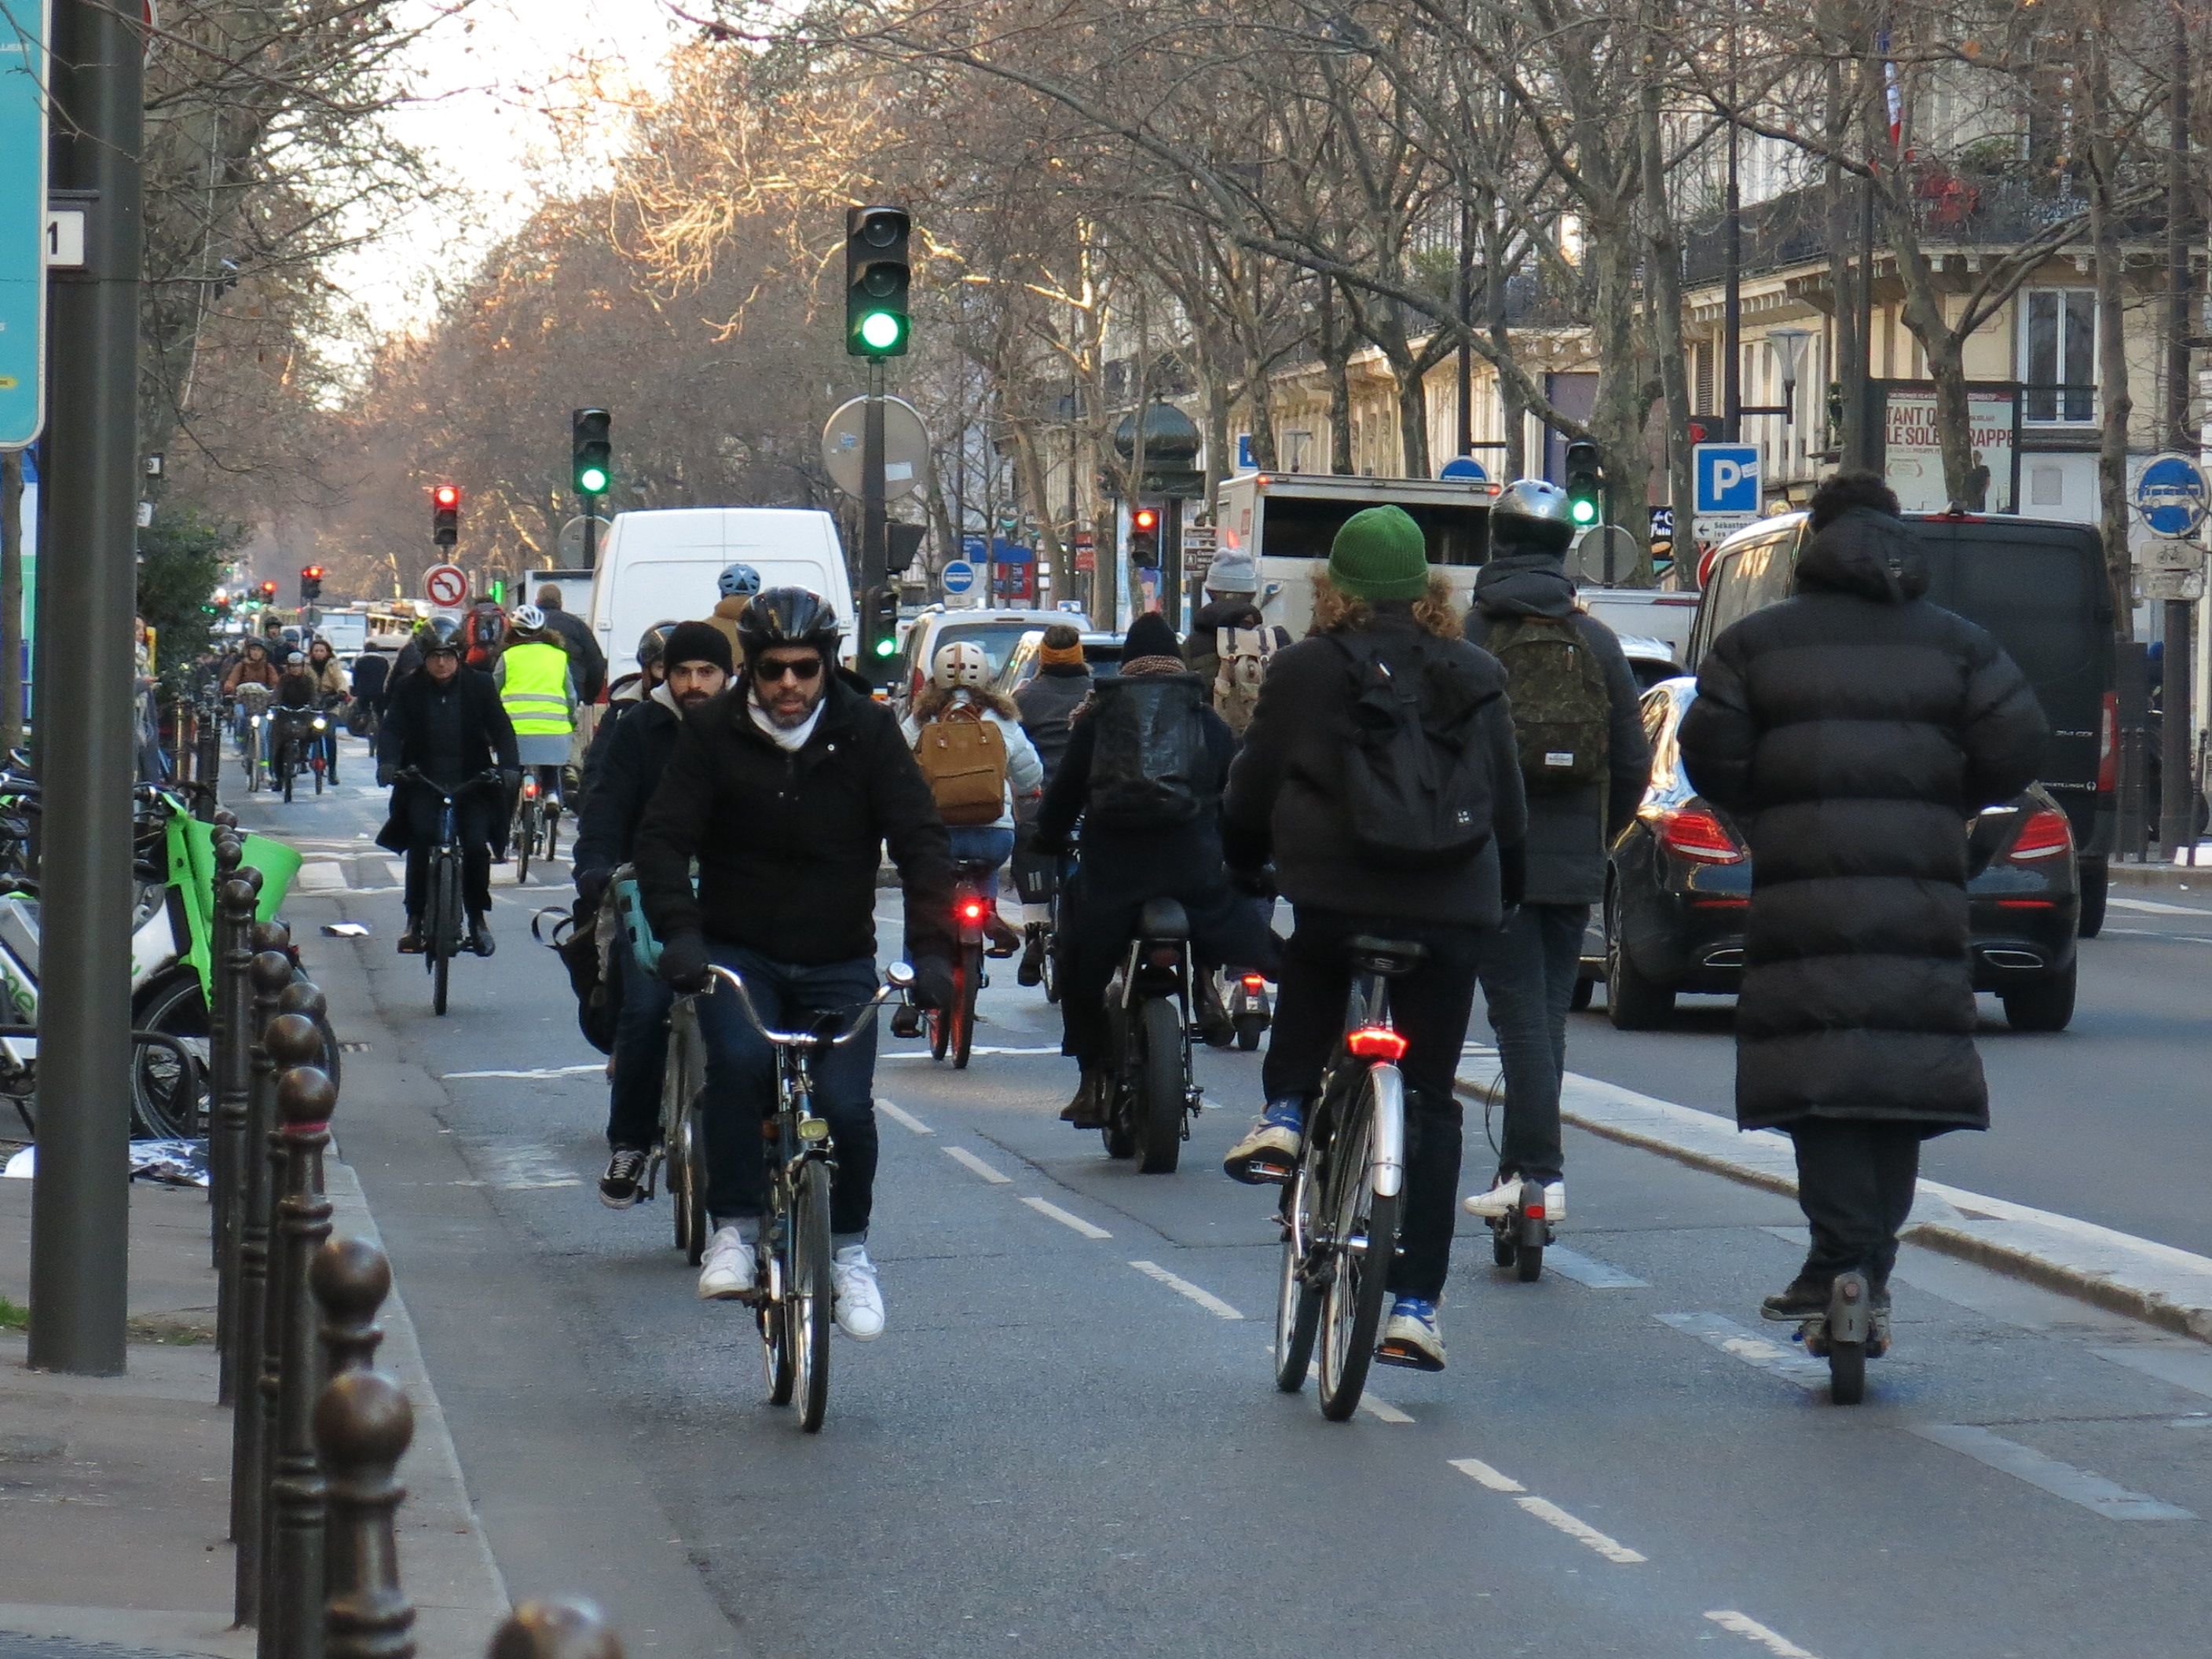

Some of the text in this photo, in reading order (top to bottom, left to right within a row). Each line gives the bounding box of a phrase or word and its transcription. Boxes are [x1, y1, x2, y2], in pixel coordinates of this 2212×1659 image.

[1886, 406, 1938, 427] TANT Q
[1886, 427, 2013, 448] LE SOLE RAPPE
[1713, 460, 1741, 500] P
